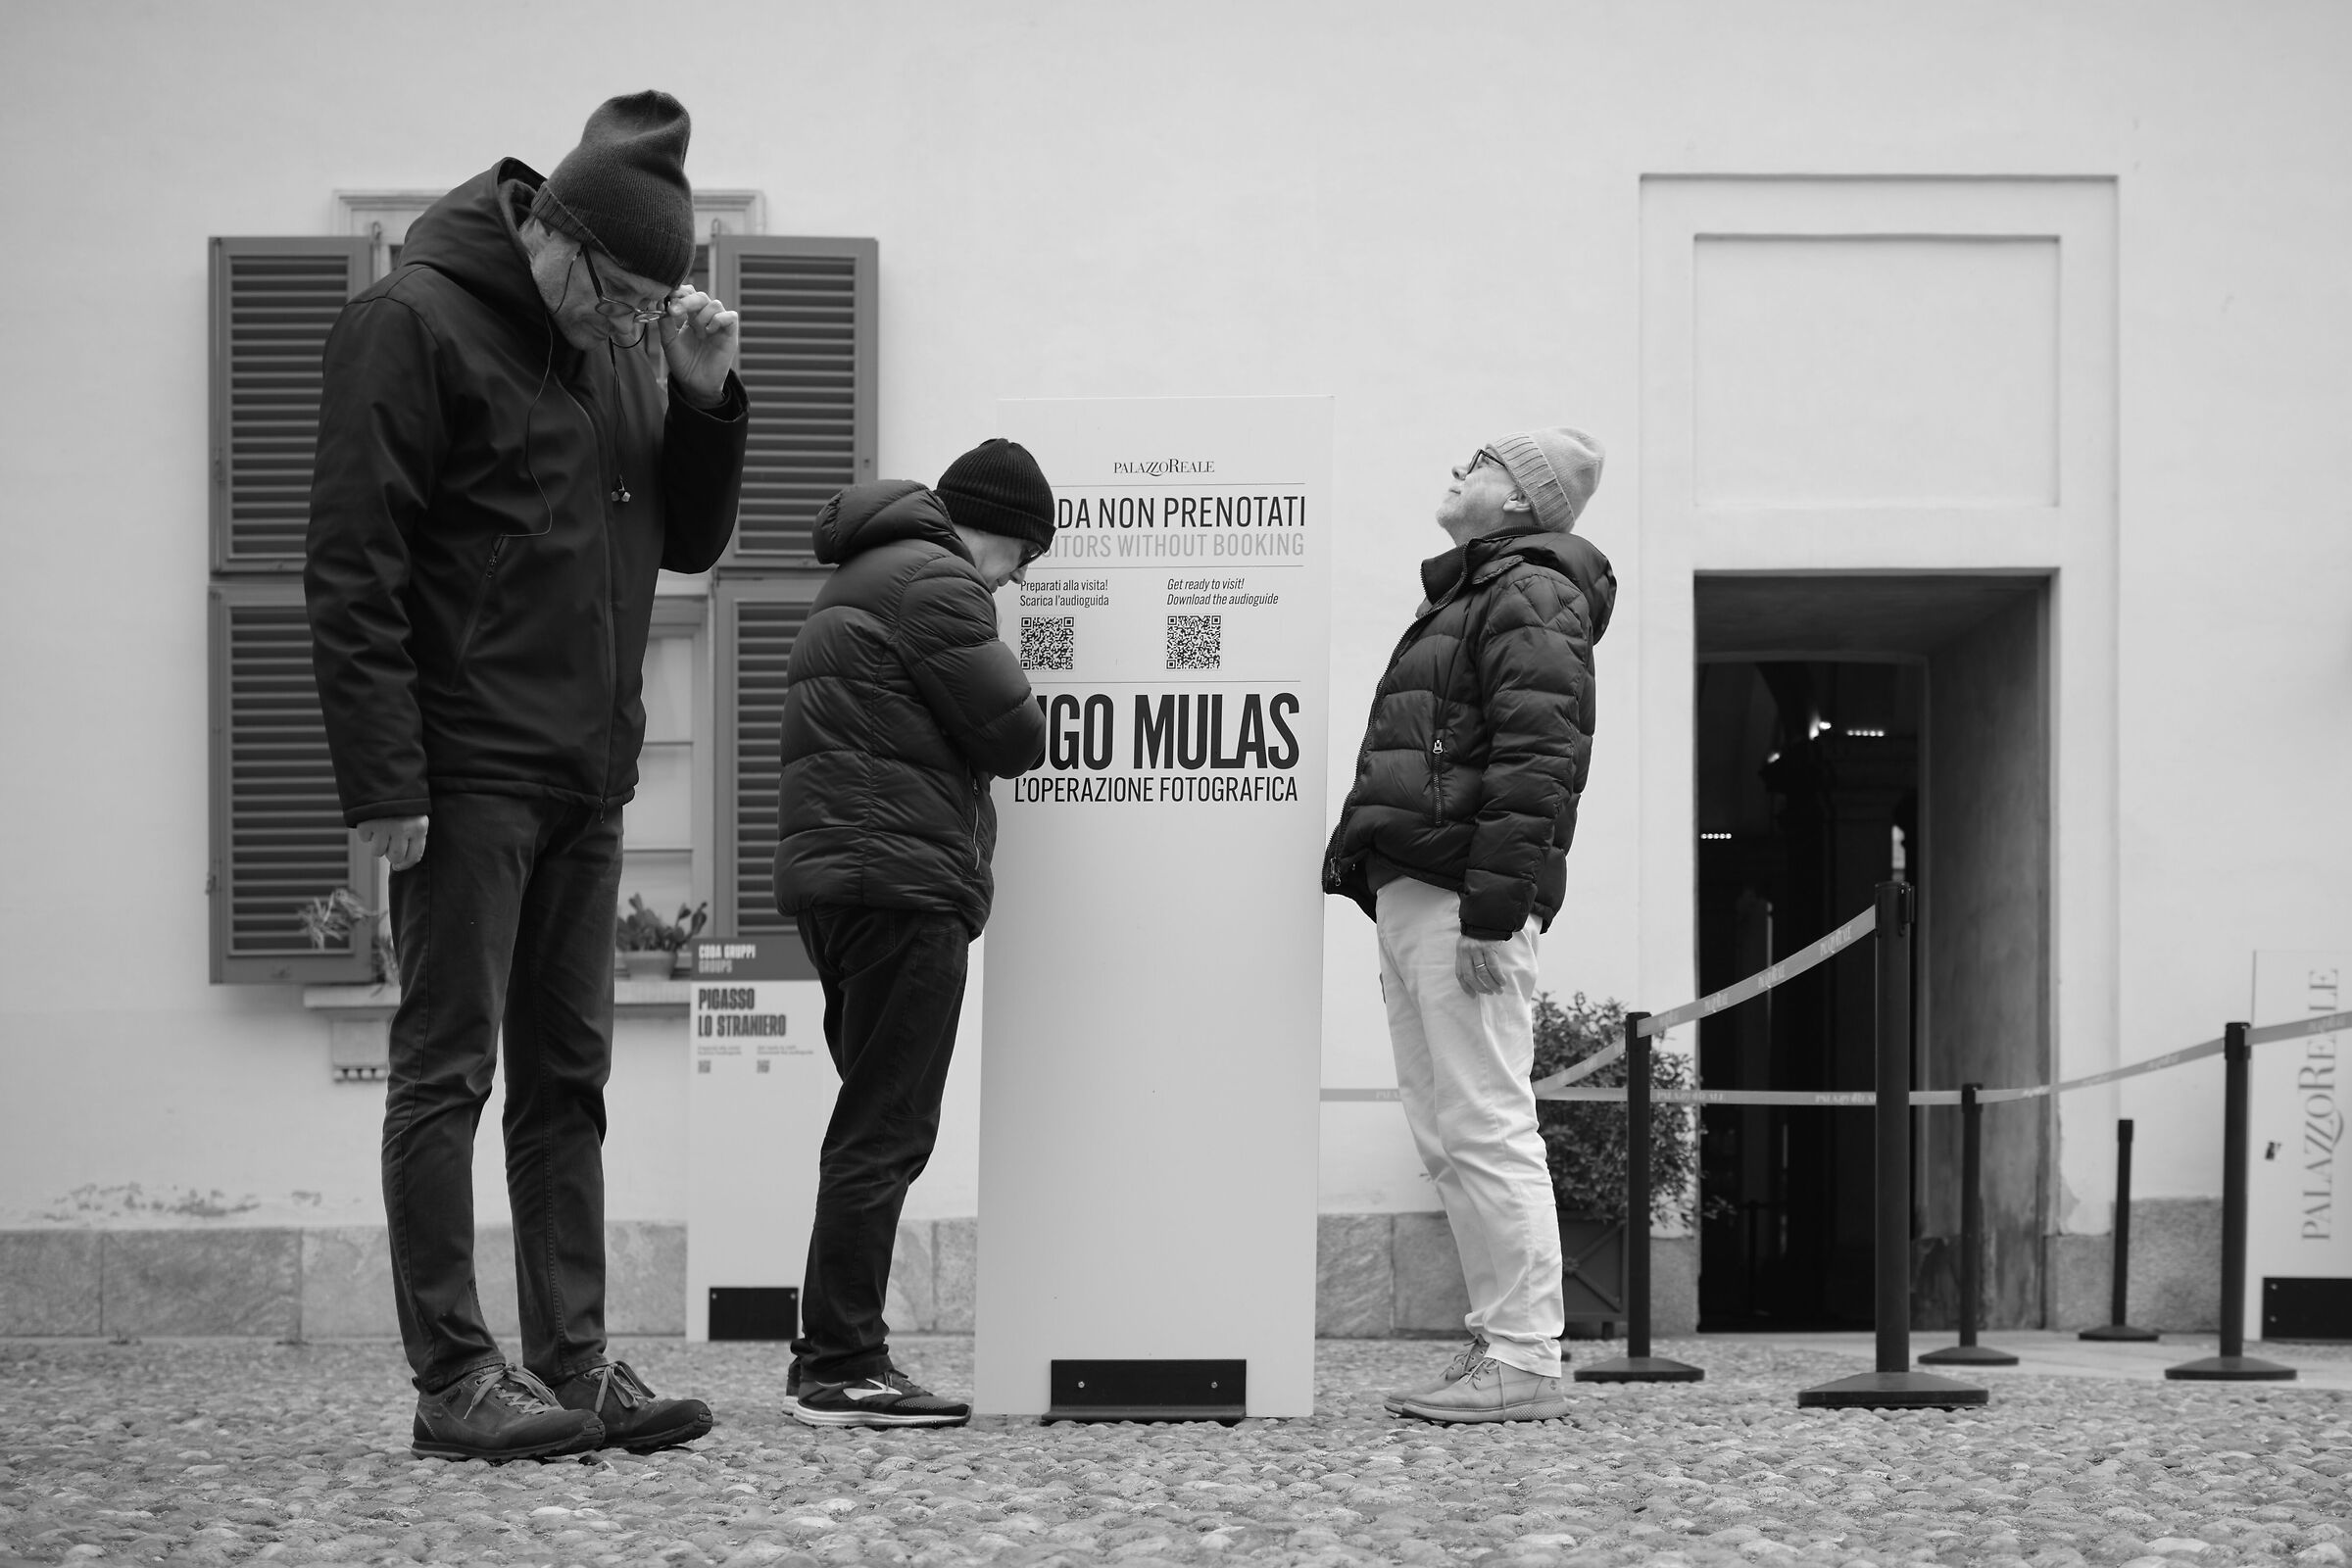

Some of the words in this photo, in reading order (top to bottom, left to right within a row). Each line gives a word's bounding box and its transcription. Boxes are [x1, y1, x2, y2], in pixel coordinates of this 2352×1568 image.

[1057, 498, 1091, 529] DA
[1099, 497, 1154, 528] NON
[1163, 496, 1306, 528] PRENOTATI
[1117, 533, 1208, 558] WITHOUT
[1213, 532, 1304, 557] BOOKING
[1020, 580, 1061, 594] Preparati
[1062, 580, 1079, 591] alla
[1080, 579, 1108, 591] visita!
[1167, 578, 1183, 590] Get
[1184, 578, 1210, 592] ready
[1211, 580, 1221, 590] to
[1222, 578, 1245, 590] visit!
[1019, 595, 1054, 607] Scarica
[1054, 594, 1109, 609] l'audioguida
[1166, 593, 1211, 606] Download
[1212, 593, 1228, 605] the
[1228, 593, 1279, 607] audioguide
[1133, 692, 1300, 770] MULAS
[1014, 777, 1154, 803] L'OPERAZIONE
[1160, 776, 1298, 802] FOTOGRAFICA
[723, 944, 757, 958] GRUPPI
[698, 988, 756, 1010] PICASSO
[698, 1014, 712, 1038] LO
[716, 1014, 787, 1038] STRANIERO
[2298, 968, 2343, 1242] PALAZZORELE
